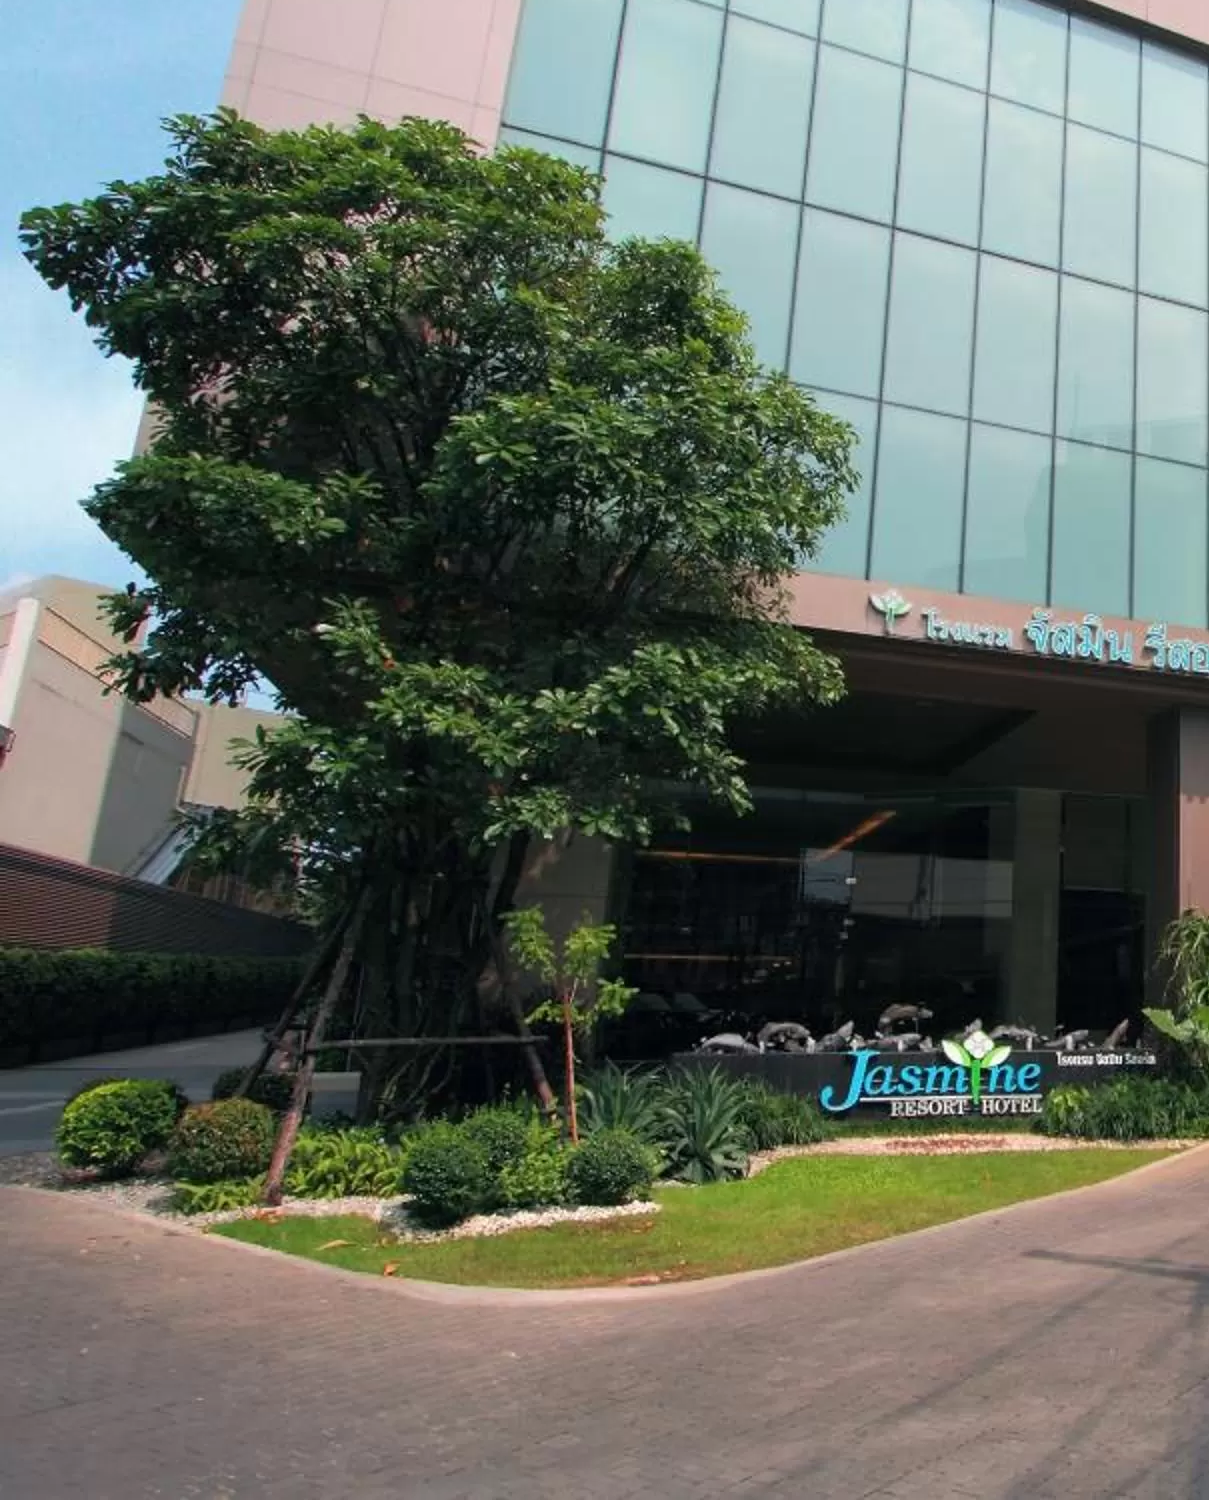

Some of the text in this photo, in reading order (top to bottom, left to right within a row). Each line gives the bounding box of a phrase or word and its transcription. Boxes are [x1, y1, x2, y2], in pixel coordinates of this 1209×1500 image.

[922, 608, 1014, 649] โรงแรม
[1026, 608, 1134, 664] จัสมิน
[819, 1048, 1042, 1112] Jasmine
[889, 1098, 1044, 1118] RESORT HOTEL
